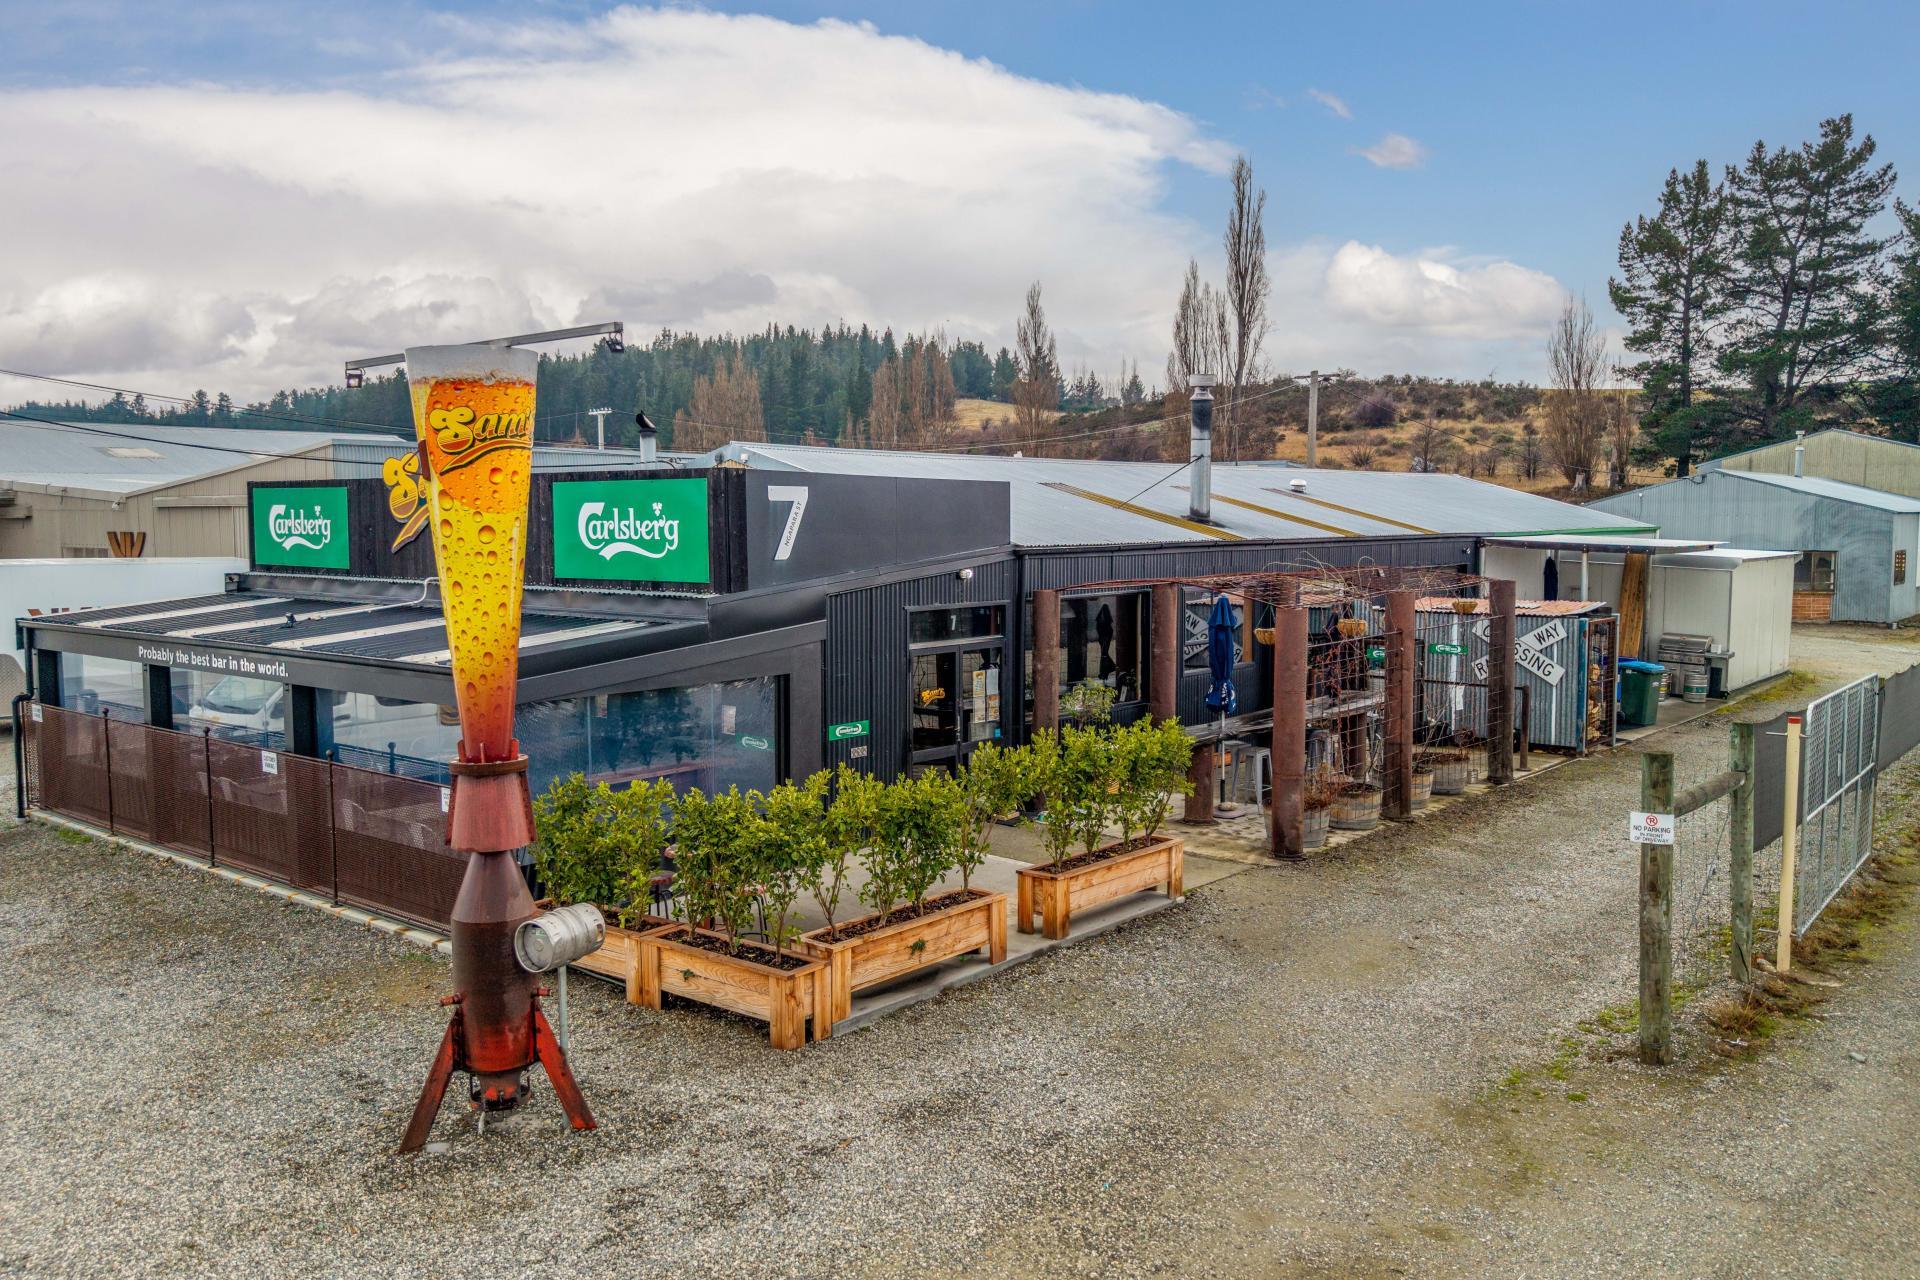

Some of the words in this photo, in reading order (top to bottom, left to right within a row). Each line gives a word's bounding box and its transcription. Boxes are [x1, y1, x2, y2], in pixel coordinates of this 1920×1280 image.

[430, 406, 535, 453] Sam'
[269, 504, 331, 551] Carlsberg
[578, 502, 679, 560] Carlsberg
[768, 486, 808, 560] 7
[1534, 623, 1560, 646] WAY
[138, 646, 174, 665] Probably
[175, 651, 189, 664] the
[191, 652, 210, 667] best
[212, 654, 227, 669] bar
[229, 656, 238, 671] in
[240, 657, 256, 673] the
[258, 661, 289, 677] world.
